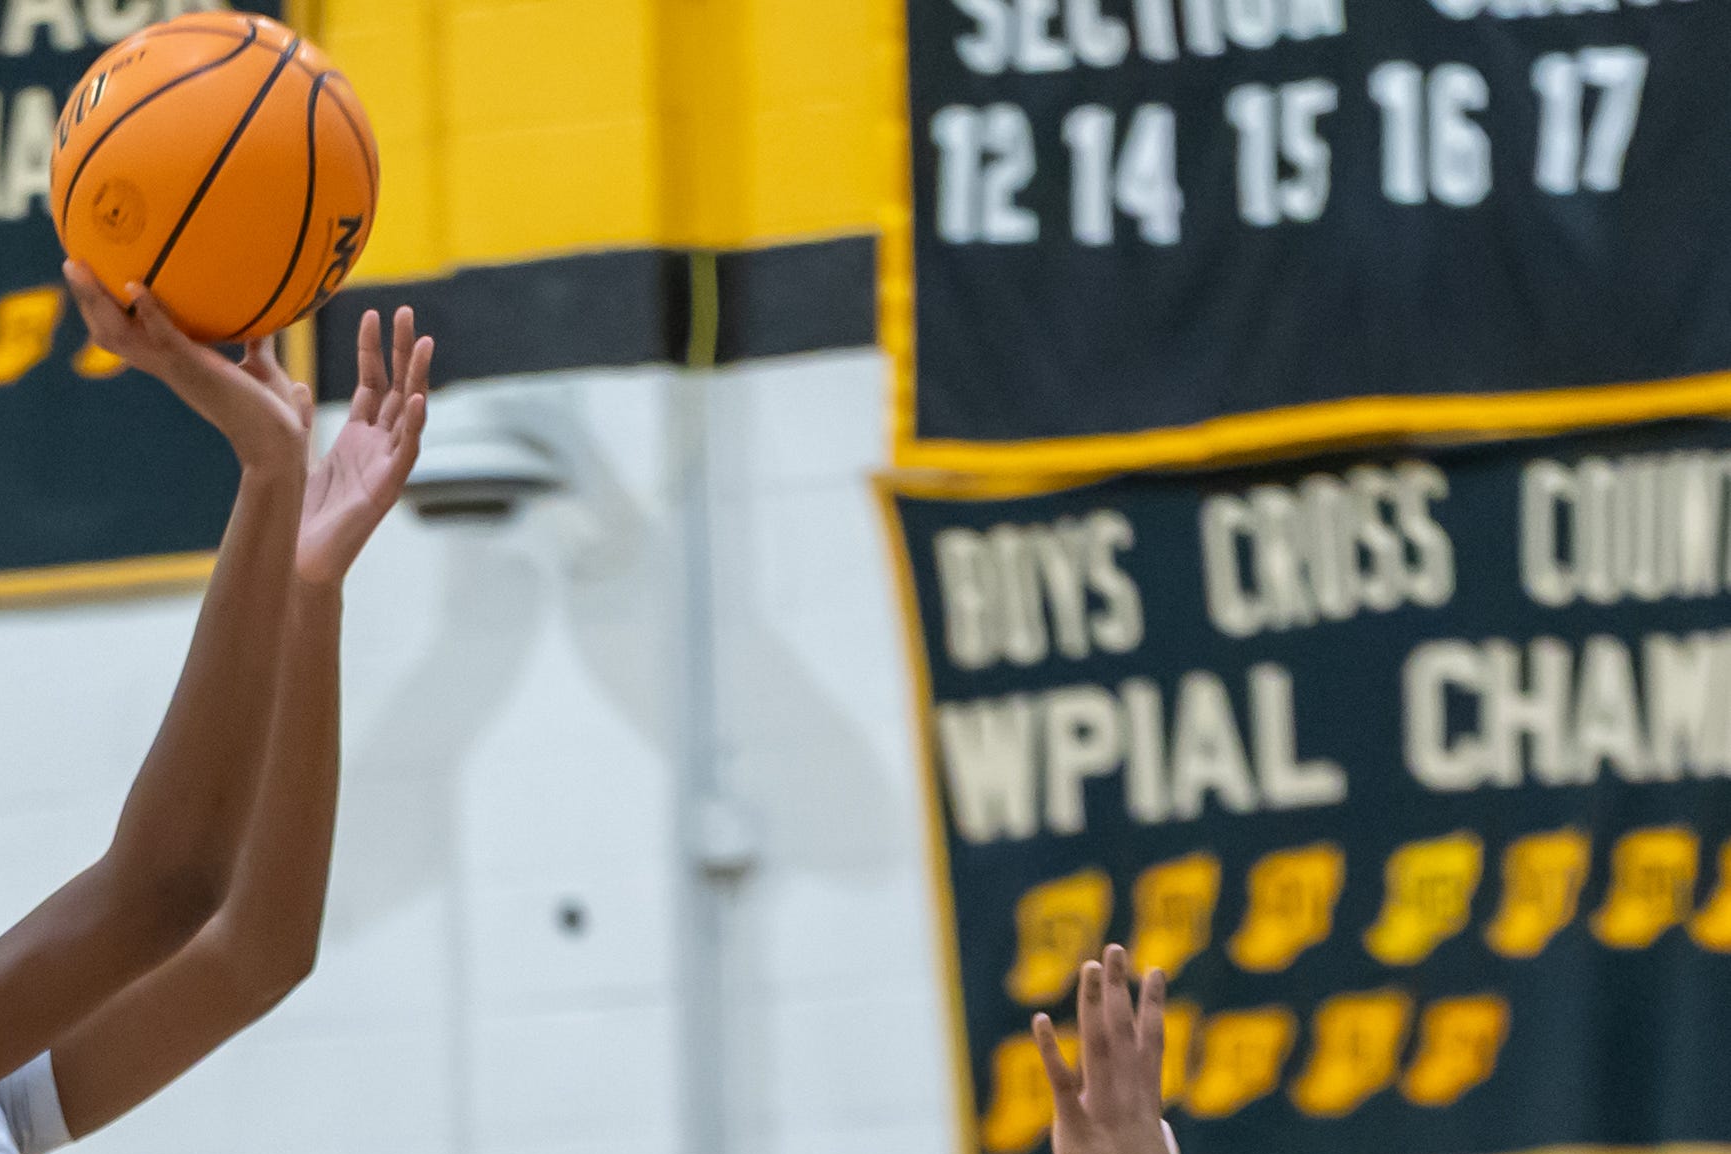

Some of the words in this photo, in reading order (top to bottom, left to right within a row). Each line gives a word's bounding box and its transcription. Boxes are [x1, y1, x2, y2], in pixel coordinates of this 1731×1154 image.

[930, 102, 1040, 246] 12
[1060, 102, 1185, 247] 14
[1224, 77, 1339, 228] 15
[1367, 59, 1494, 208] 16
[1530, 44, 1649, 196] 17
[933, 508, 1145, 671] BOYS
[1201, 460, 1457, 640] CROSS
[935, 662, 1348, 846] WPIAL
